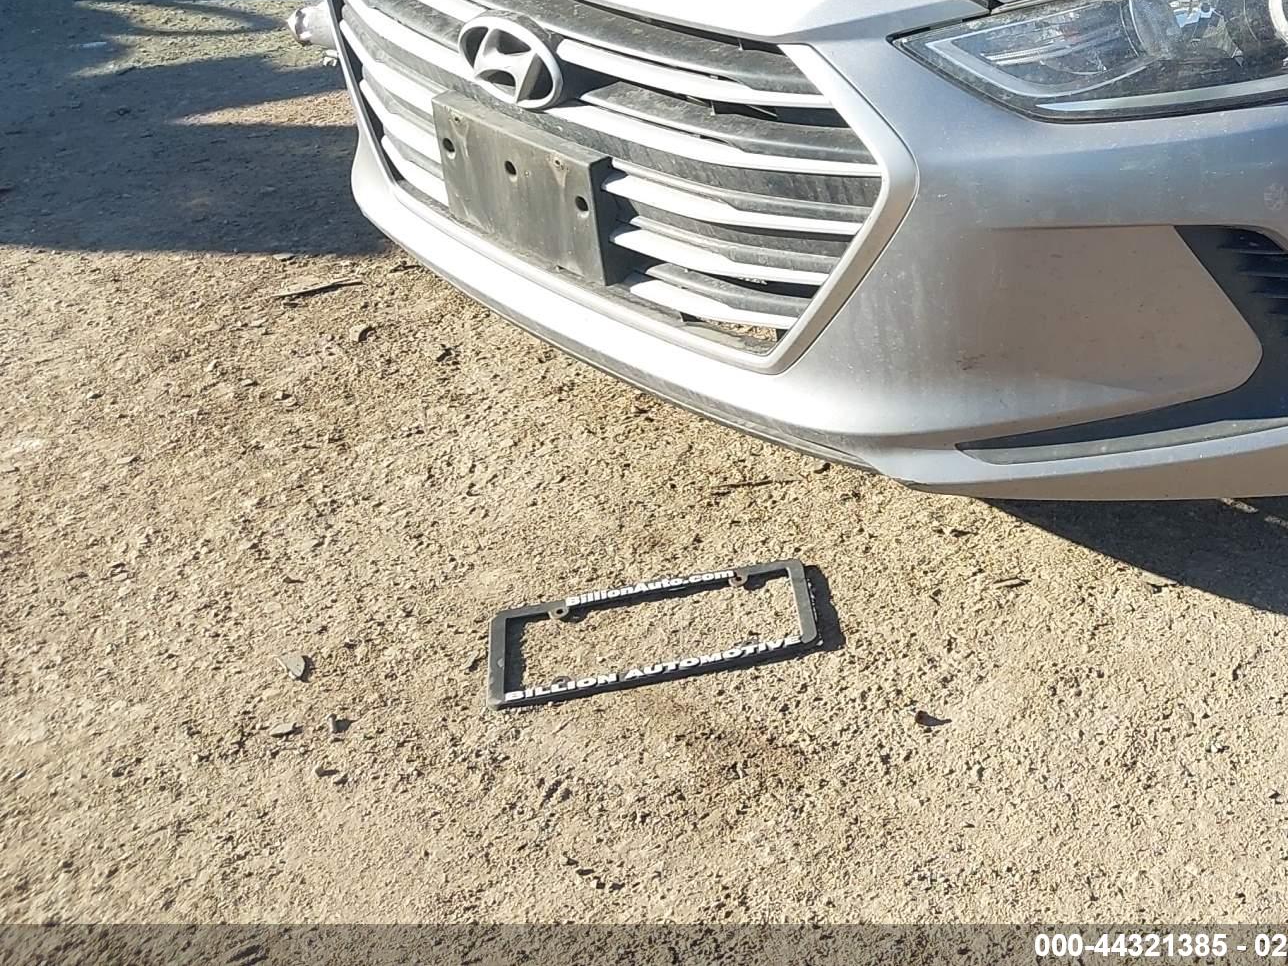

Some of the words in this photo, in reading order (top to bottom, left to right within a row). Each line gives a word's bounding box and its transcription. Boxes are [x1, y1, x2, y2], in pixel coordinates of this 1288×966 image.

[565, 569, 735, 607] BillionAuto.com
[504, 673, 618, 702] BILLION
[624, 635, 802, 680] AUTOMOTIVE
